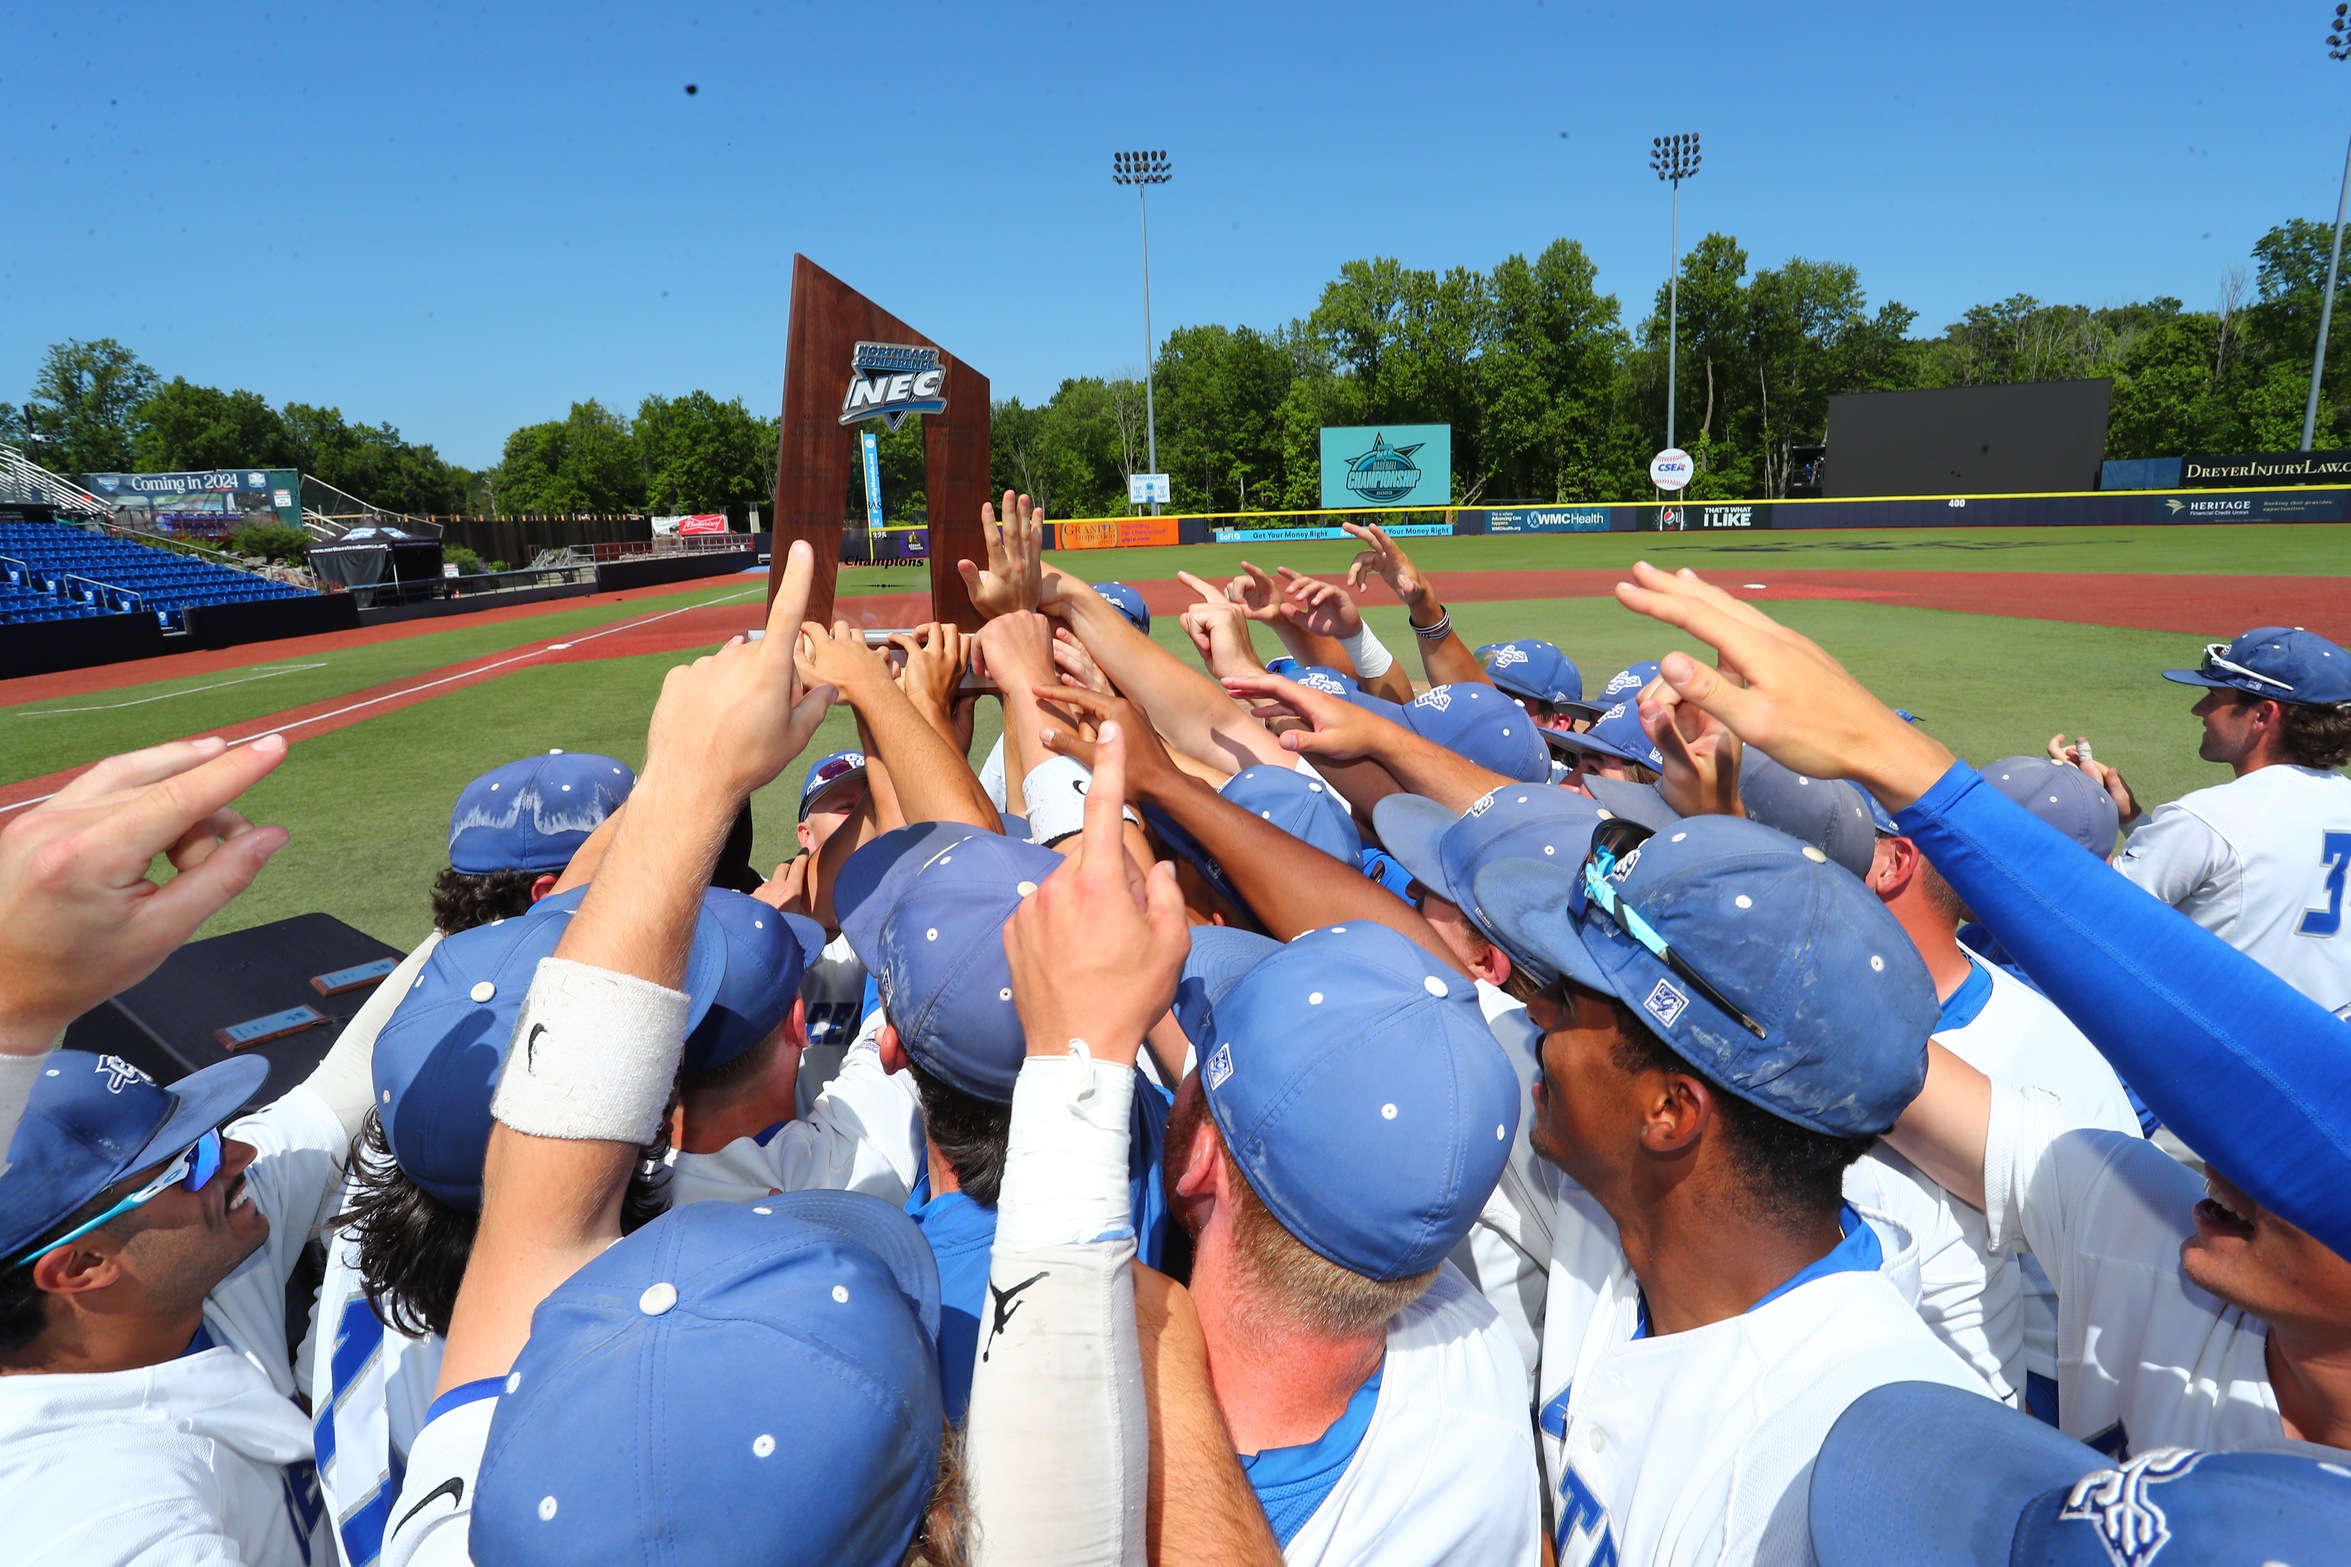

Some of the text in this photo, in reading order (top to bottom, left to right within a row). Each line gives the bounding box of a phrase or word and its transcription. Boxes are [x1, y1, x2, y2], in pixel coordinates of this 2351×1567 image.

[858, 346, 937, 359] NORTHEAST
[857, 357, 936, 370] CONFERENCE
[848, 369, 942, 410] NEC
[1372, 460, 1397, 470] BASEBALL
[1658, 463, 1685, 472] CSEA
[131, 473, 239, 493] Coming in 2024
[1347, 469, 1421, 489] CHAMPIONSHIP
[1948, 498, 1966, 508] 400
[2190, 501, 2251, 510] HERITAGE
[686, 520, 720, 529] Budweiser
[1538, 512, 1604, 525] WMCHealth
[1703, 513, 1752, 527] I LIKE
[1219, 529, 1328, 541] SoFi Get Your Money Right
[1405, 528, 1429, 536] Money
[1430, 526, 1450, 536] Right
[1075, 534, 1116, 543] Inspection
[844, 555, 924, 569] Champions
